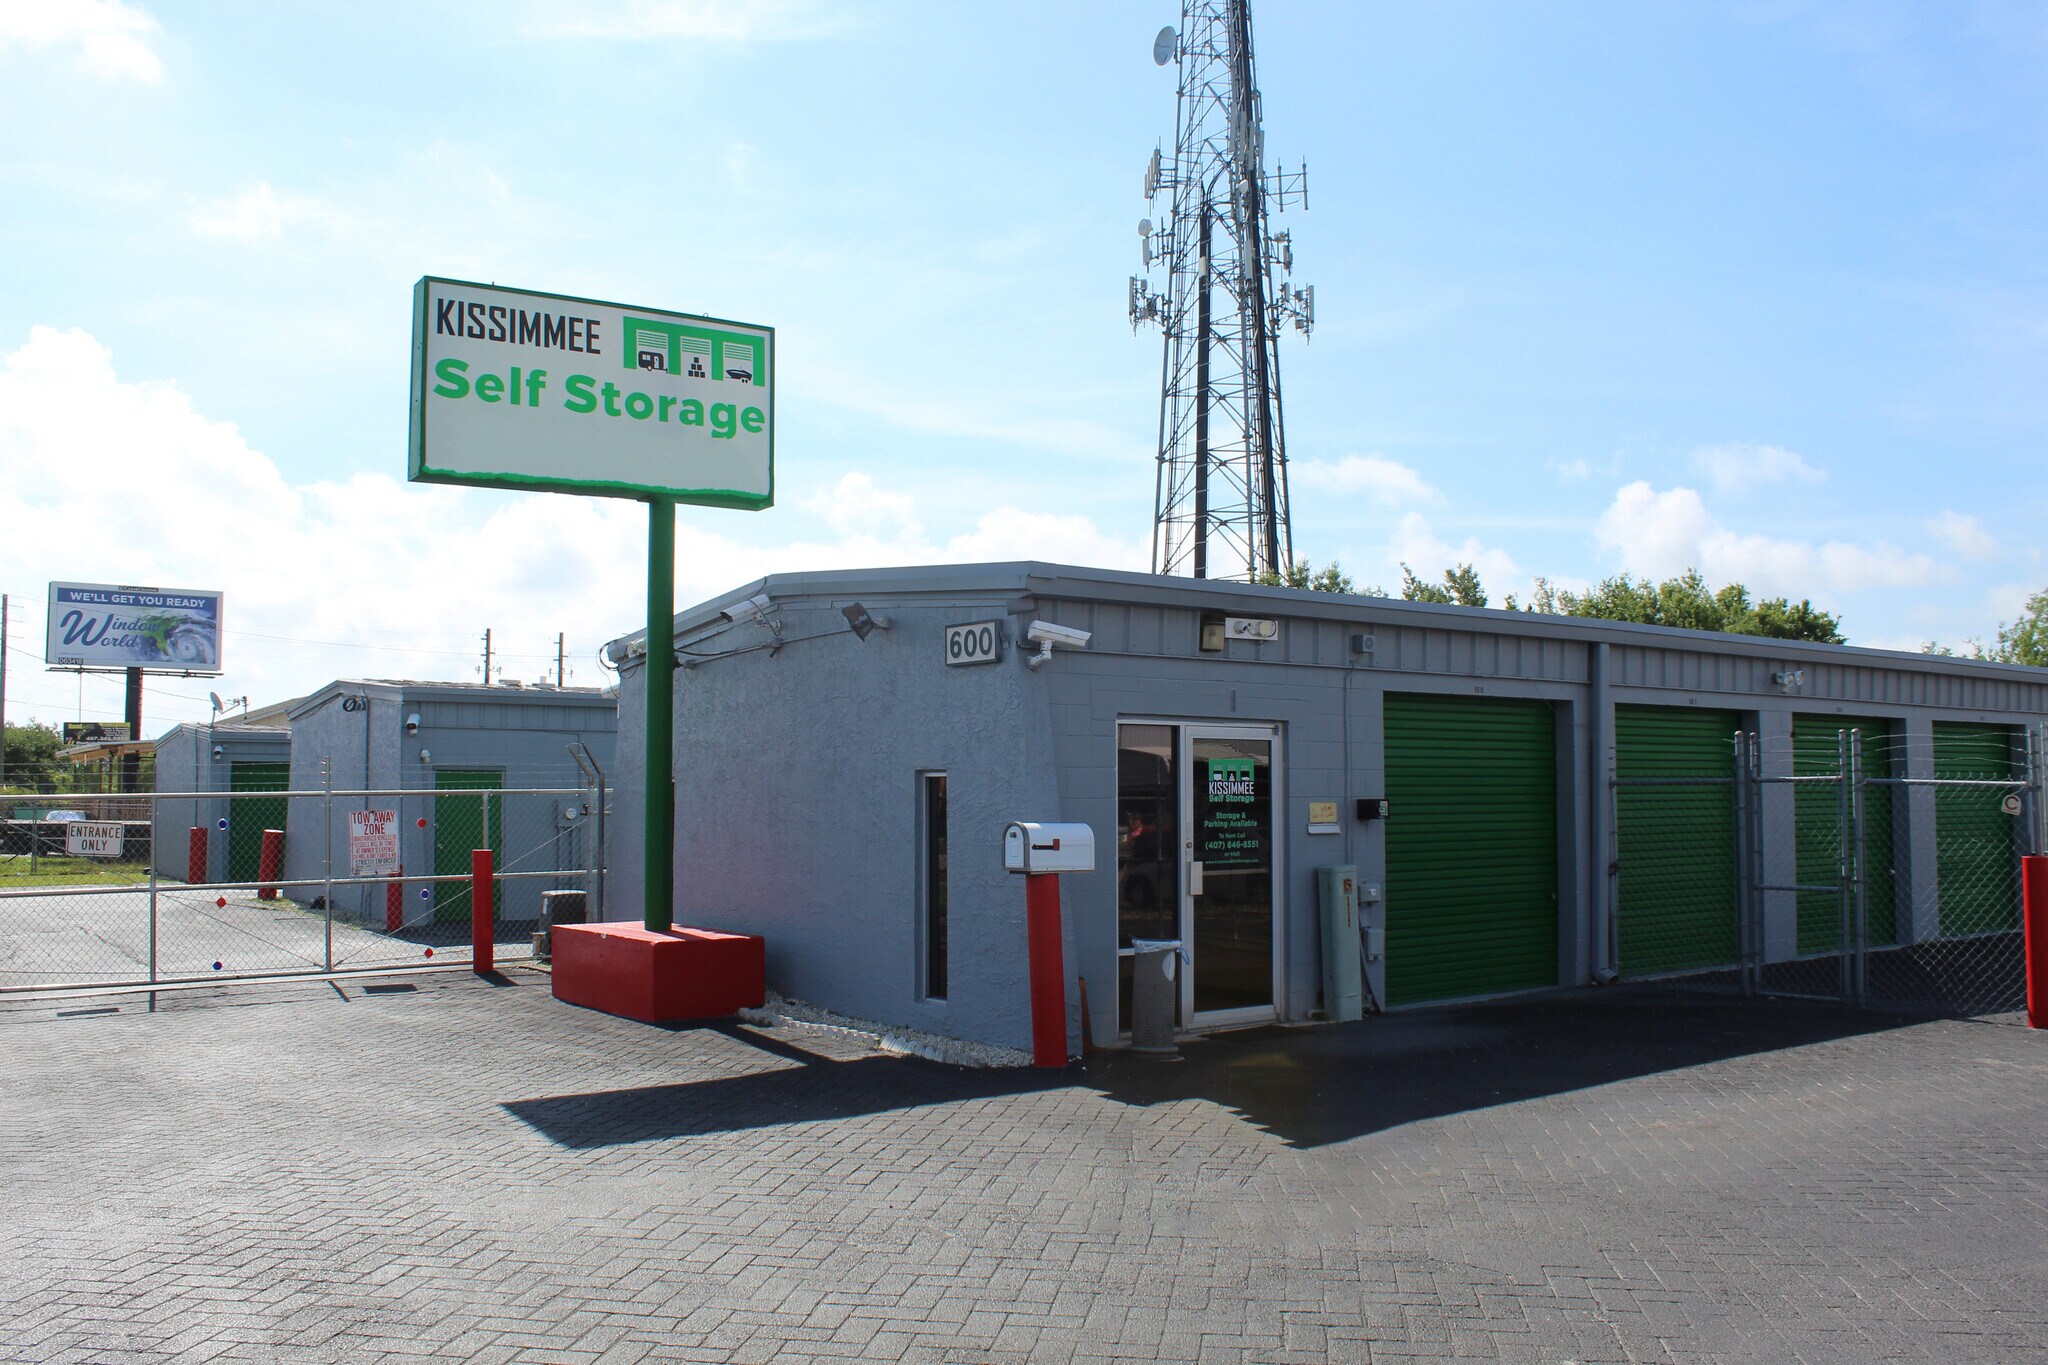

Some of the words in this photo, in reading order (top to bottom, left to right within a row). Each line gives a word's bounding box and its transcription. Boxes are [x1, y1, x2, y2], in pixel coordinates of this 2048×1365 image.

[437, 298, 601, 355] KISSIMMEE
[433, 358, 548, 408] Self
[563, 374, 766, 439] Storage
[70, 592, 108, 602] WE'LL
[112, 595, 135, 604] GET
[138, 596, 163, 605] YOU
[166, 598, 206, 608] READY
[950, 627, 993, 659] 600
[1208, 782, 1254, 794] KISSIMMEE
[1226, 794, 1254, 803] Storage
[352, 812, 370, 824] TOW
[374, 811, 395, 823] AWAY
[1216, 812, 1240, 820] Storage
[70, 826, 120, 838] ENTRANCE
[364, 823, 385, 835] ZONE
[82, 840, 107, 850] ONLY
[1206, 841, 1225, 850] (407)
